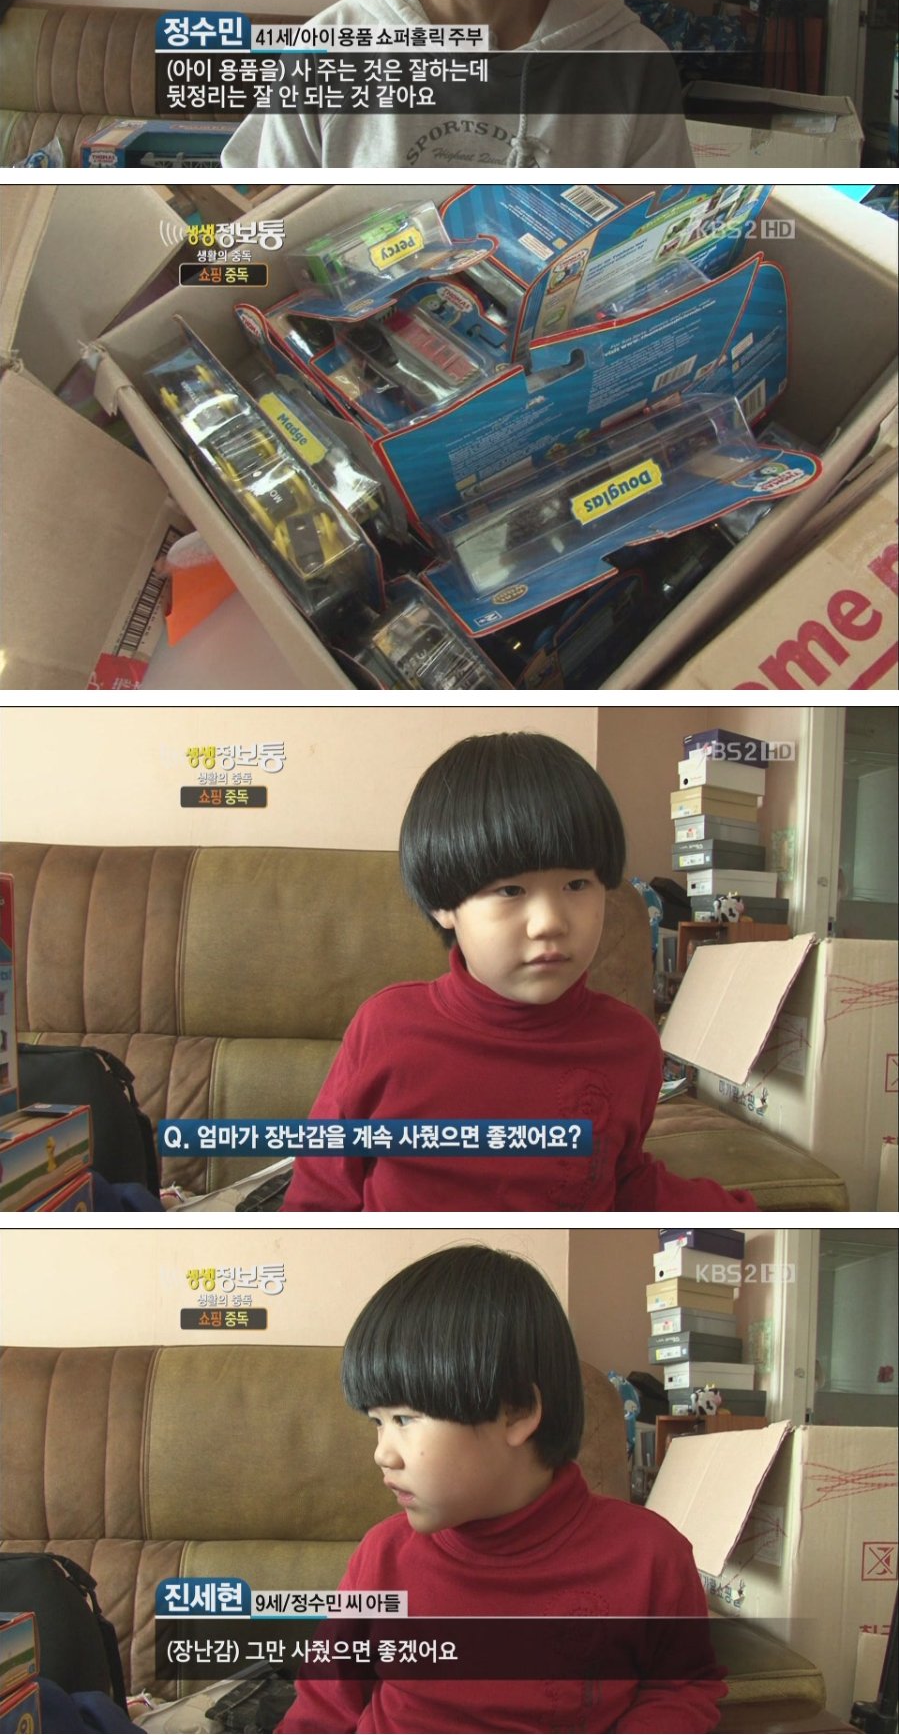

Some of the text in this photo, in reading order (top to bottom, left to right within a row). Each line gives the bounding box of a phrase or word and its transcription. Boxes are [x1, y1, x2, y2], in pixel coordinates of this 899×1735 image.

[406, 119, 489, 166] SPORTS
[380, 235, 416, 261] Percy
[276, 413, 309, 447] Madge
[583, 470, 652, 513] Douglas
